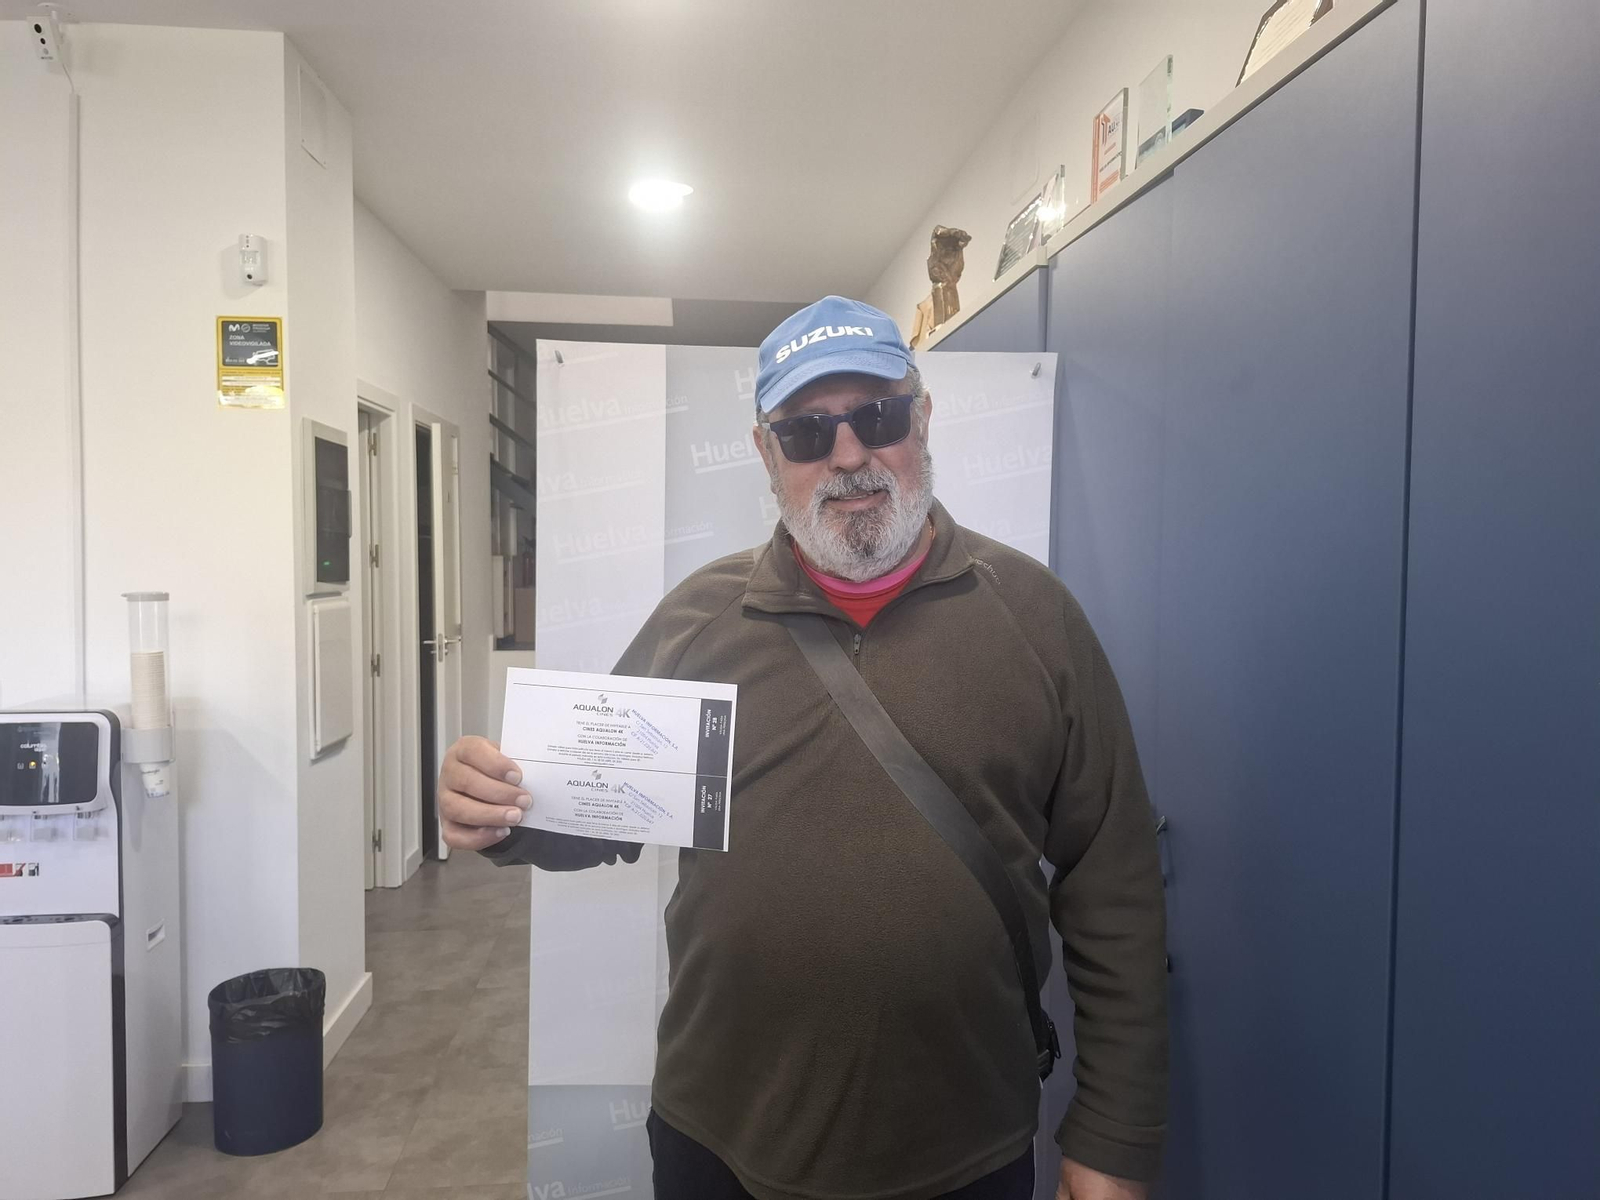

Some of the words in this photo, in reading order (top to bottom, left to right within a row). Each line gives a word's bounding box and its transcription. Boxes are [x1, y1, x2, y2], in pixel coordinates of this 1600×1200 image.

[775, 326, 874, 364] SUZUKI
[552, 524, 648, 559] Huelva
[573, 704, 614, 713] AQUALON
[616, 708, 630, 718] 4K
[631, 709, 646, 723] HUELVA
[567, 779, 609, 789] AQUALON
[611, 784, 625, 794] 4K
[624, 782, 639, 794] HUELVA
[609, 1098, 651, 1124] Hu
